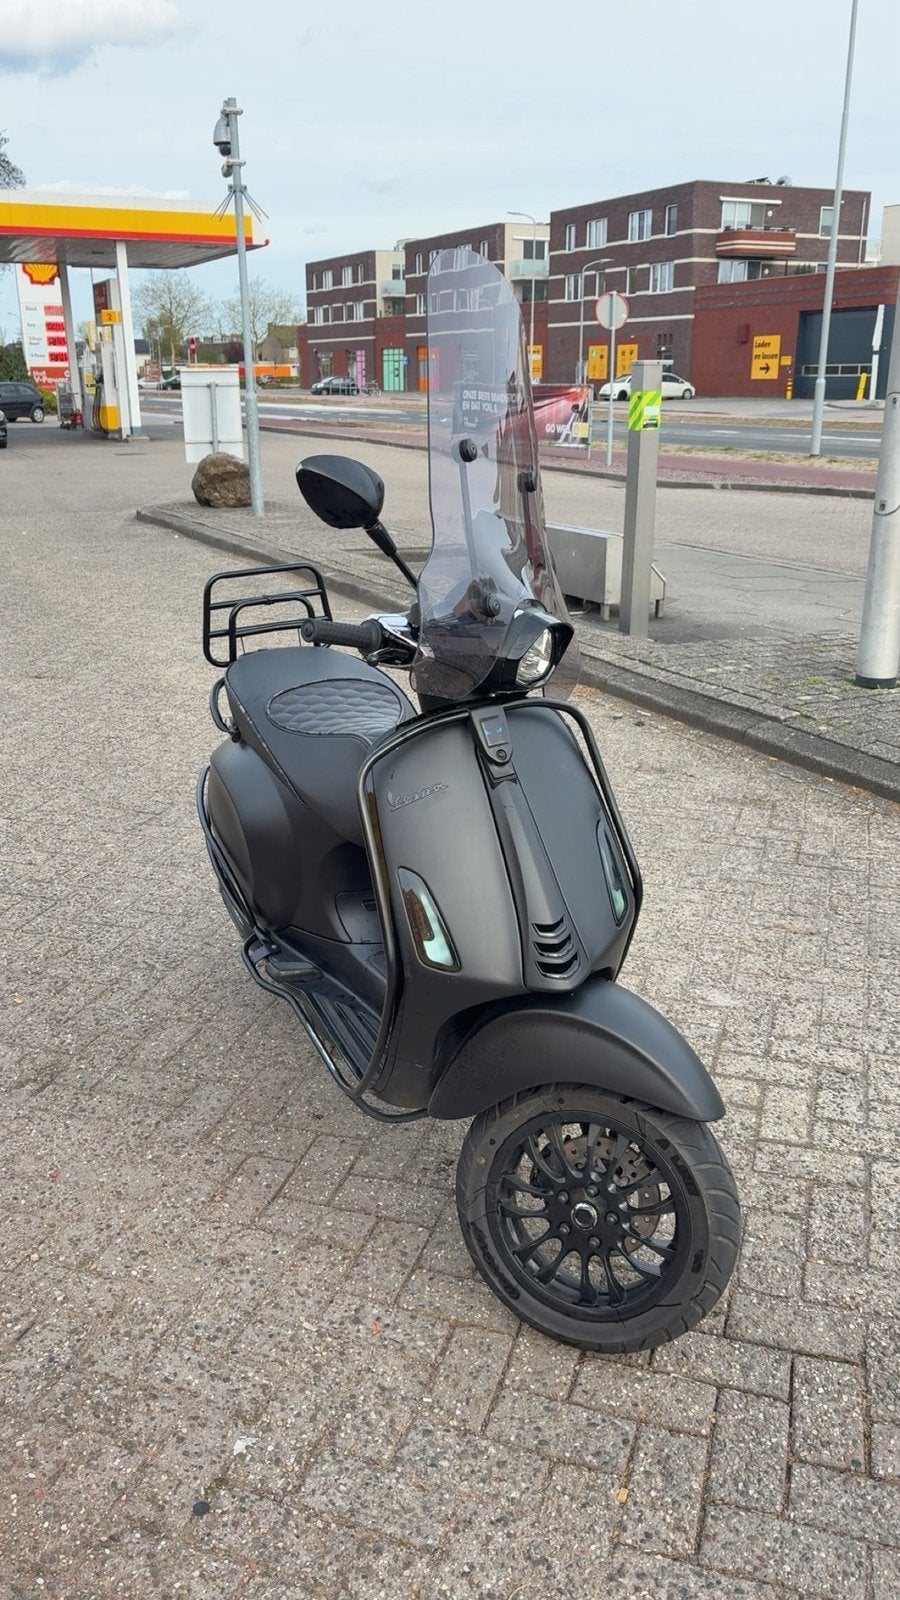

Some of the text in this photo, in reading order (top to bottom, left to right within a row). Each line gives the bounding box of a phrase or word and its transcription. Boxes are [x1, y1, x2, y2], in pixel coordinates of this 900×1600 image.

[106, 313, 112, 321] 2
[755, 340, 771, 348] Laden
[462, 400, 470, 410] EN
[545, 423, 556, 433] GO
[387, 782, 449, 812] Vespa
